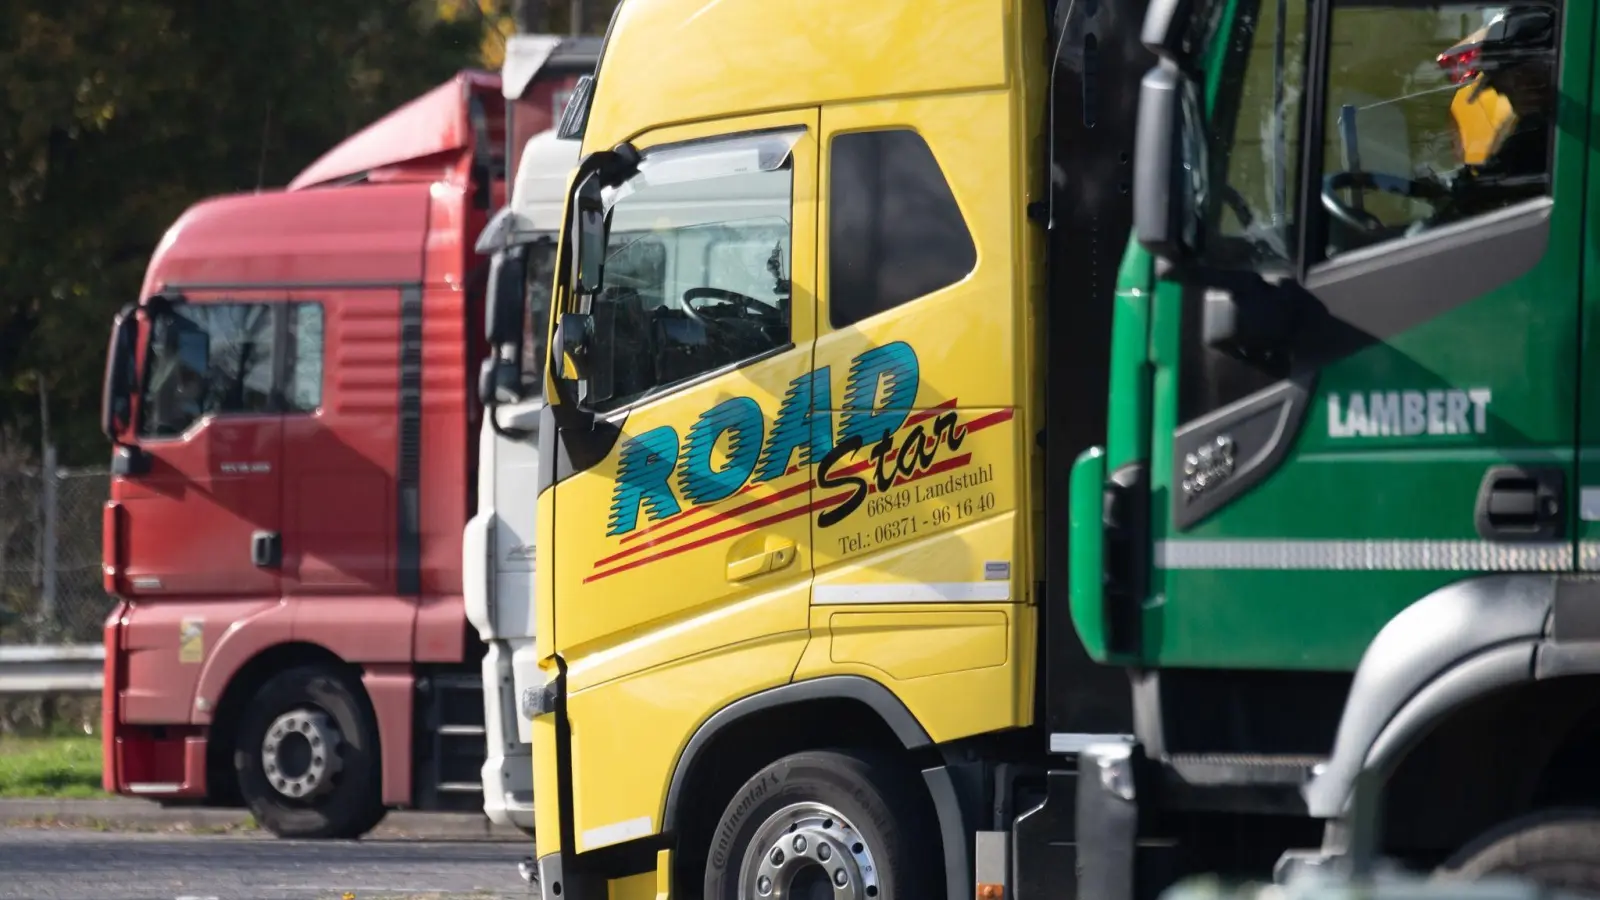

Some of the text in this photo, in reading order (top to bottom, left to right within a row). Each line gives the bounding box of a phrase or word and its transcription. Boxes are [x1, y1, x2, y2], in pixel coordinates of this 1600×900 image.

[606, 341, 919, 537] ROAD
[1328, 389, 1491, 437] LAMBERT
[817, 411, 967, 529] Star
[867, 464, 994, 518] 66849 Landstuhl
[838, 533, 871, 555] Tel.:
[874, 516, 918, 544] 06371
[932, 505, 951, 527] 96
[956, 498, 973, 520] 16
[977, 492, 995, 513] 40
[713, 777, 768, 870] Continental
